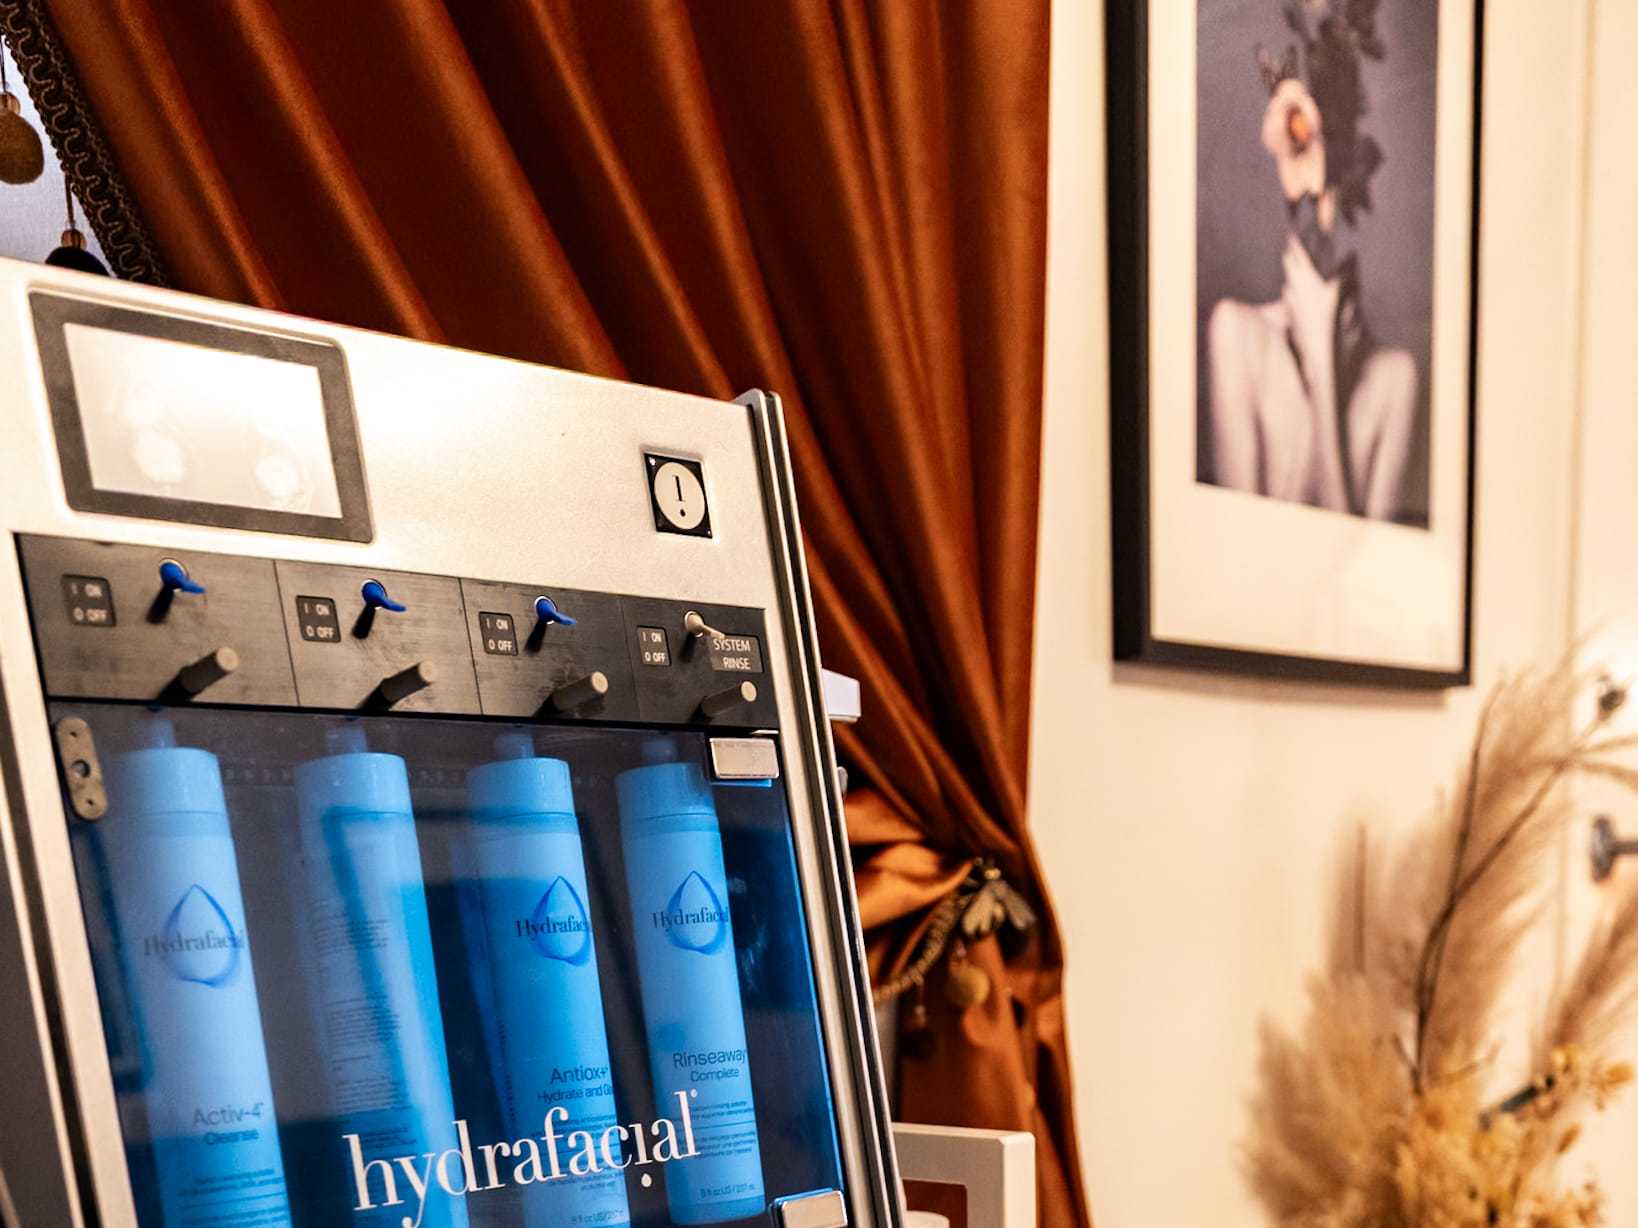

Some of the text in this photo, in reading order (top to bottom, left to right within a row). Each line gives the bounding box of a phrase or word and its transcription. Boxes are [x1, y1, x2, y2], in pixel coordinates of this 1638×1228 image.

[315, 603, 331, 616] ON
[496, 618, 510, 630] ON
[316, 626, 335, 639] OFF
[651, 632, 662, 643] ON
[497, 639, 513, 651] OFF
[712, 637, 751, 653] SYSTEM
[652, 651, 666, 663] OFF
[722, 656, 752, 671] RINSE
[690, 1066, 741, 1083] Complete
[536, 1086, 584, 1105] Hydrate
[584, 1084, 603, 1098] and
